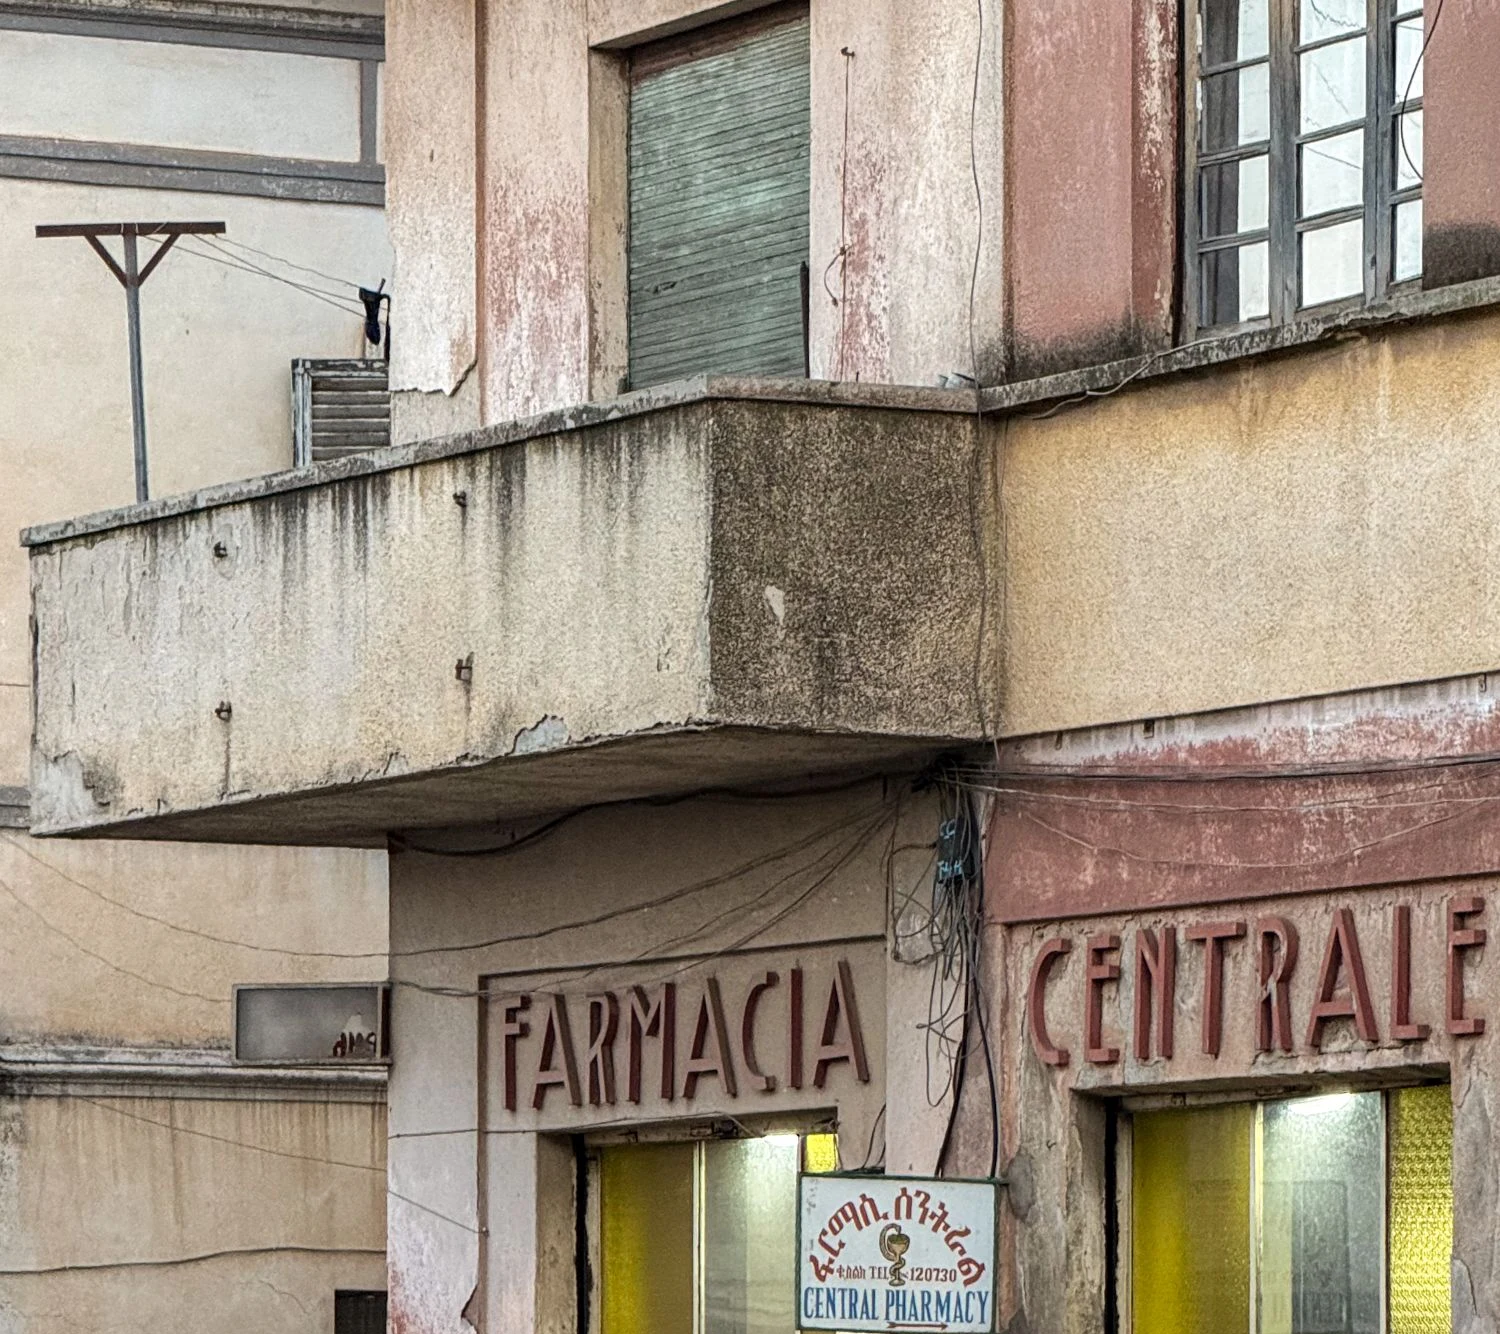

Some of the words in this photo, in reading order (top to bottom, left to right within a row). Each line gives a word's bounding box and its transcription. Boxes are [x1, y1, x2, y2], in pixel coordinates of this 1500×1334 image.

[502, 959, 871, 1111] FARMACIA
[1027, 896, 1487, 1067] CENTRALE
[809, 1193, 889, 1284] ፋርማሲ
[894, 1187, 986, 1288] ሰንትራል
[803, 1286, 879, 1321] CENTRAL
[884, 1287, 989, 1325] PHARMACY
